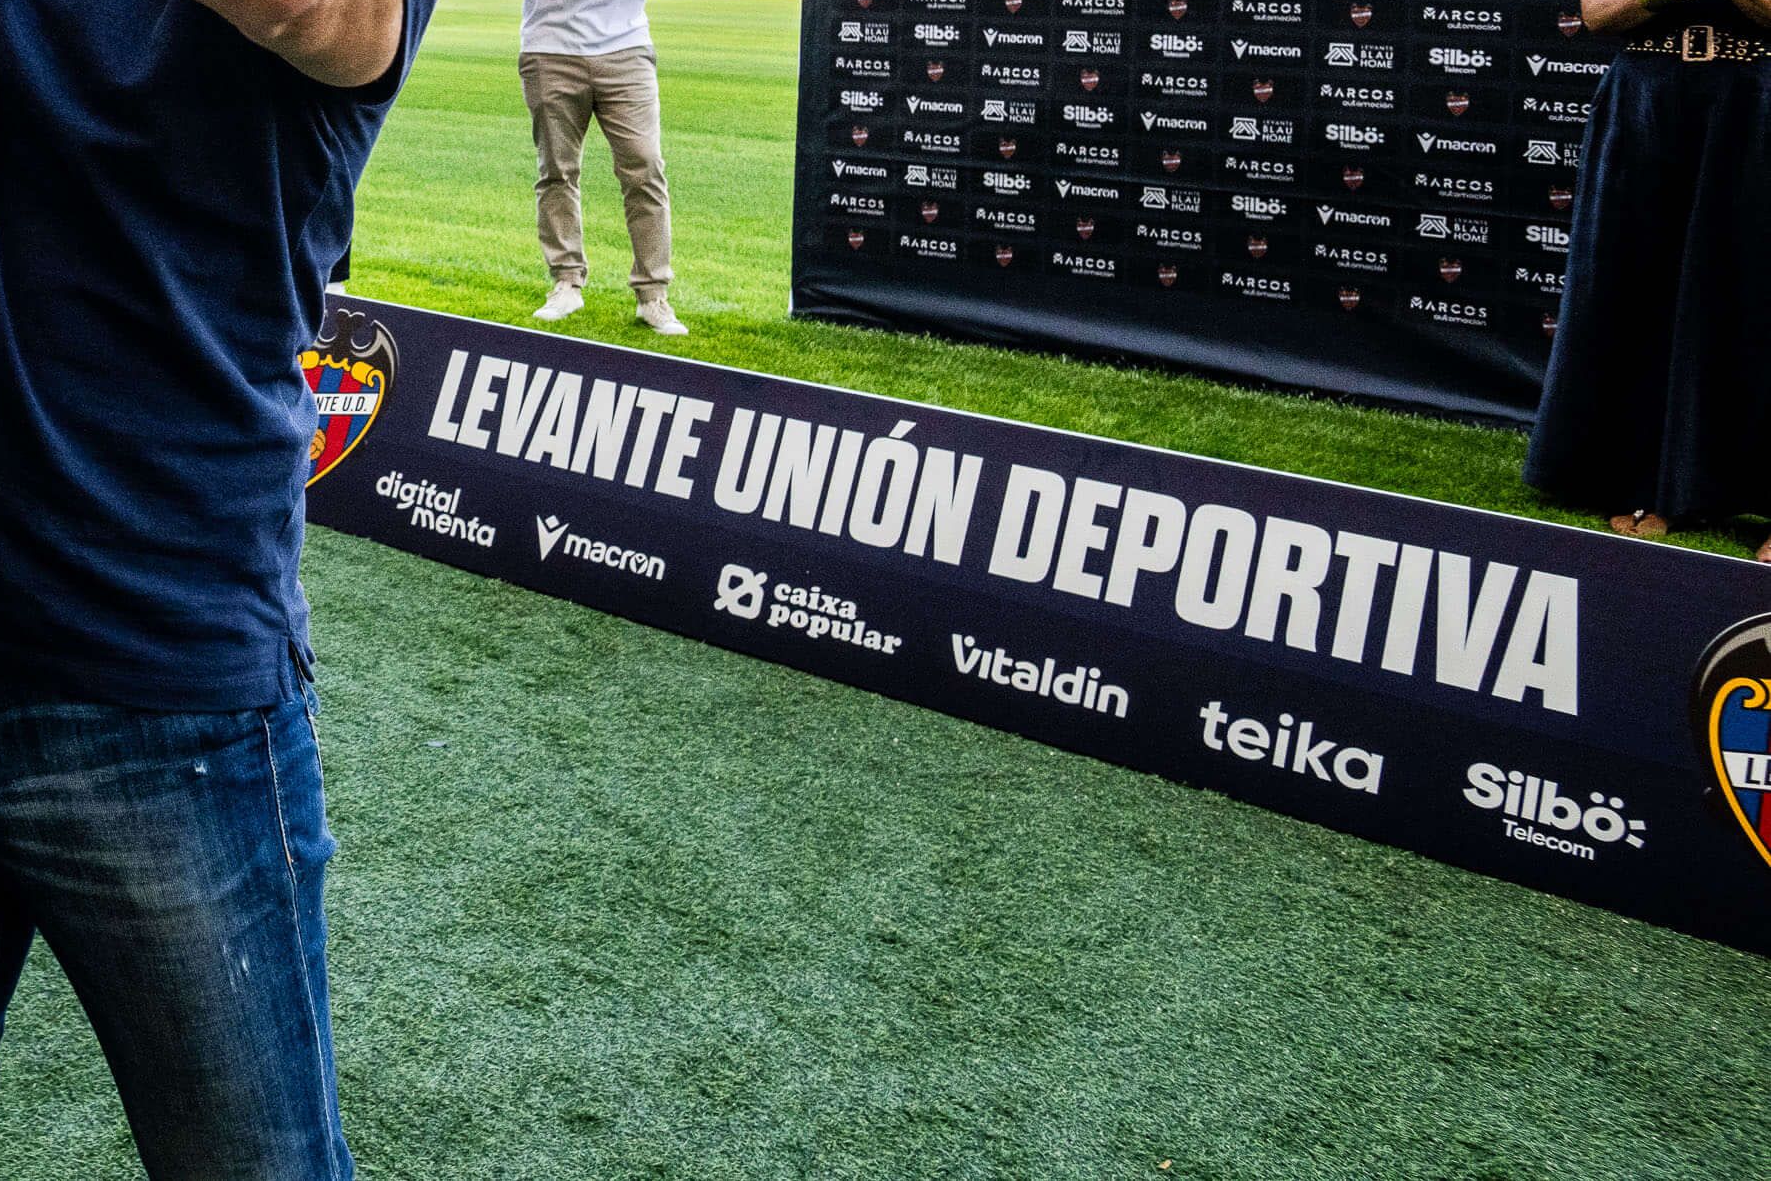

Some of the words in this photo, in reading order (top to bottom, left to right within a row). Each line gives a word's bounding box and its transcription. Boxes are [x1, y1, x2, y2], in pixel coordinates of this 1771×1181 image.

[1232, 0, 1301, 13] MARCOS
[1424, 7, 1502, 22] MARCOS
[998, 34, 1042, 44] macron
[1248, 45, 1301, 57] macron
[1361, 50, 1394, 59] BLAU
[1360, 58, 1394, 68] HOME
[1547, 62, 1610, 74] macron
[1142, 73, 1207, 88] MARCOS
[1320, 85, 1393, 100] MARCOS
[1157, 118, 1206, 130] macron
[1263, 124, 1292, 134] BLAU
[1262, 133, 1292, 143] HOME
[1057, 143, 1118, 157] MARCOS
[1437, 139, 1496, 153] macron
[1226, 157, 1292, 171] MARCOS
[1416, 174, 1492, 192] MARCOS
[1072, 185, 1118, 198] macron
[1335, 211, 1390, 226] macron
[1137, 225, 1201, 242] MARCOS
[1454, 223, 1488, 234] BLAU
[1454, 232, 1488, 243] HOME
[1053, 253, 1115, 269] MARCOS
[1316, 245, 1387, 262] MARCOS
[1222, 273, 1290, 291] MARCOS
[1410, 297, 1487, 318] MARCOS
[376, 471, 461, 515] digital
[411, 506, 496, 547] menta
[428, 349, 714, 501] LEVANTE
[713, 407, 982, 567] UNIÓN
[988, 464, 1579, 716] DEPORTIVA
[563, 533, 666, 581] macron
[773, 579, 858, 620] caixa
[767, 601, 903, 654] popular
[951, 633, 1129, 719] vitaldin
[1200, 701, 1384, 795] teika
[1502, 819, 1595, 861] Telecom
